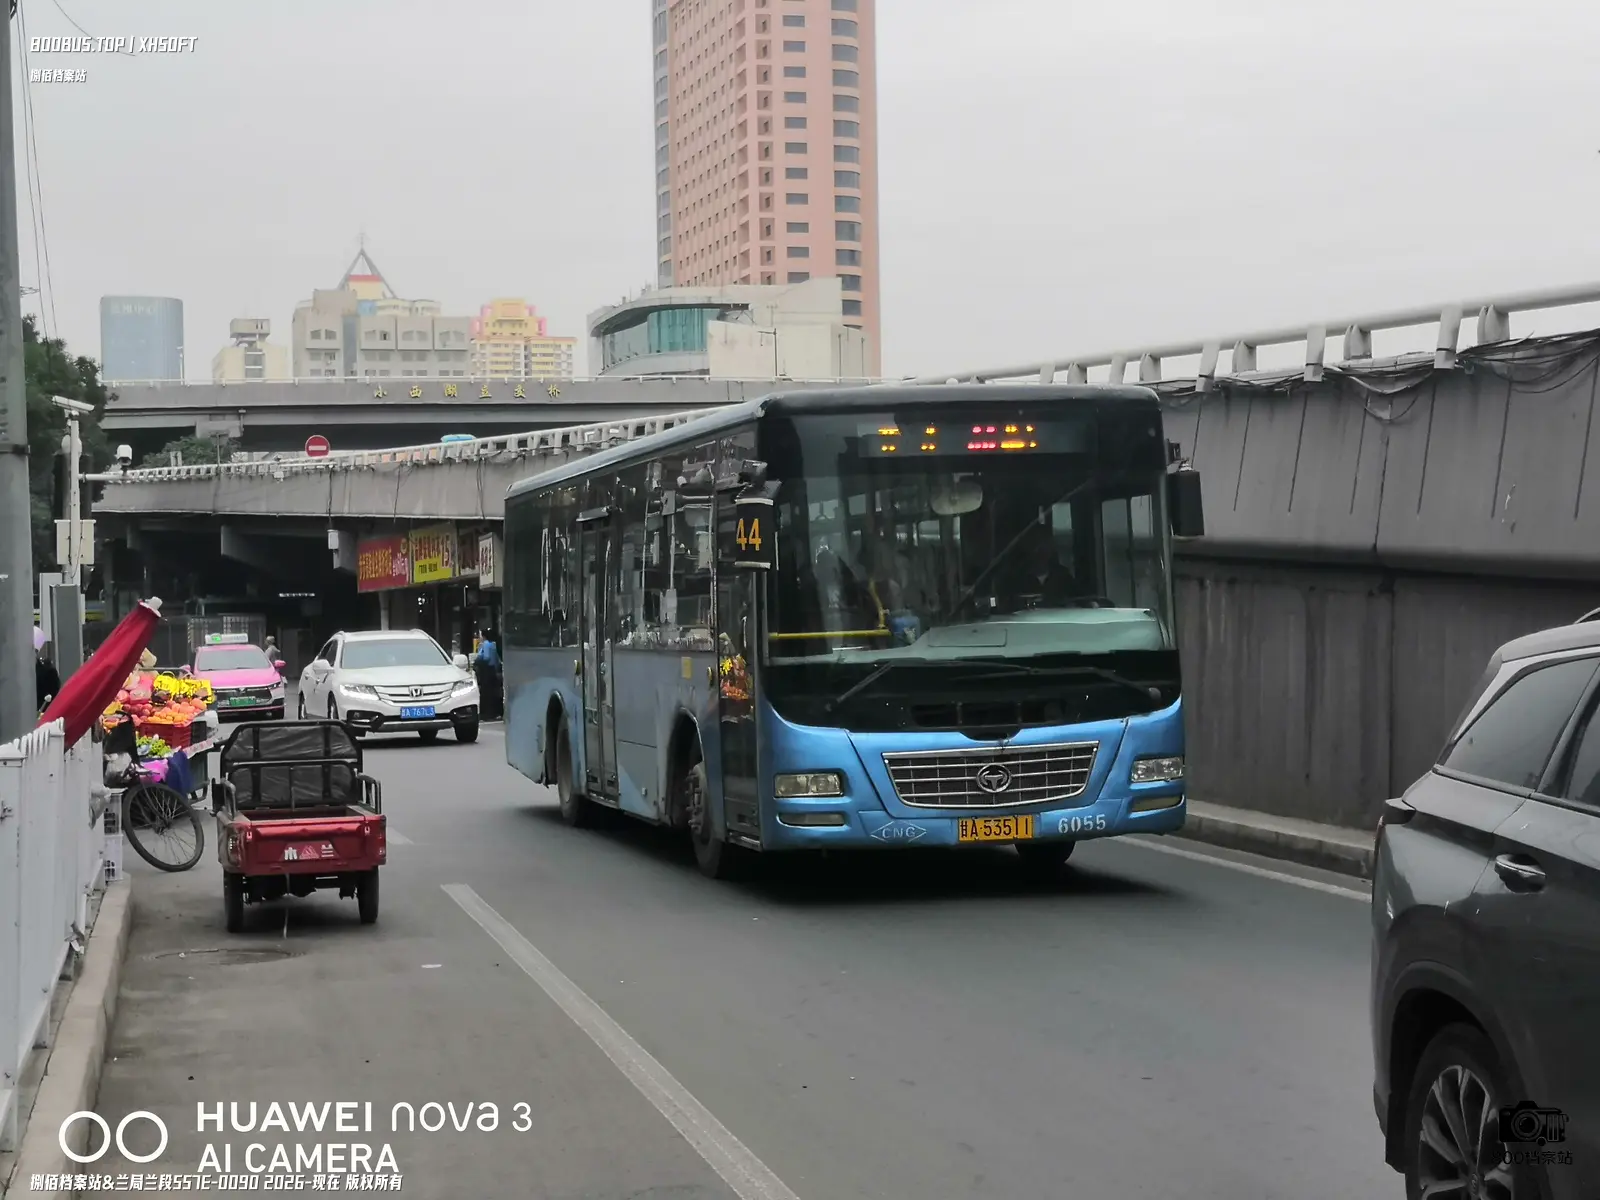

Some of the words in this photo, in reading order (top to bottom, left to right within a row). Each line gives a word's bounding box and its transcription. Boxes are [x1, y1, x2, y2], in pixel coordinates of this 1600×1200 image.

[374, 383, 561, 399] 小西湖立交桥
[736, 518, 762, 551] 44
[882, 826, 915, 838] CNG
[1058, 813, 1107, 834] 6055
